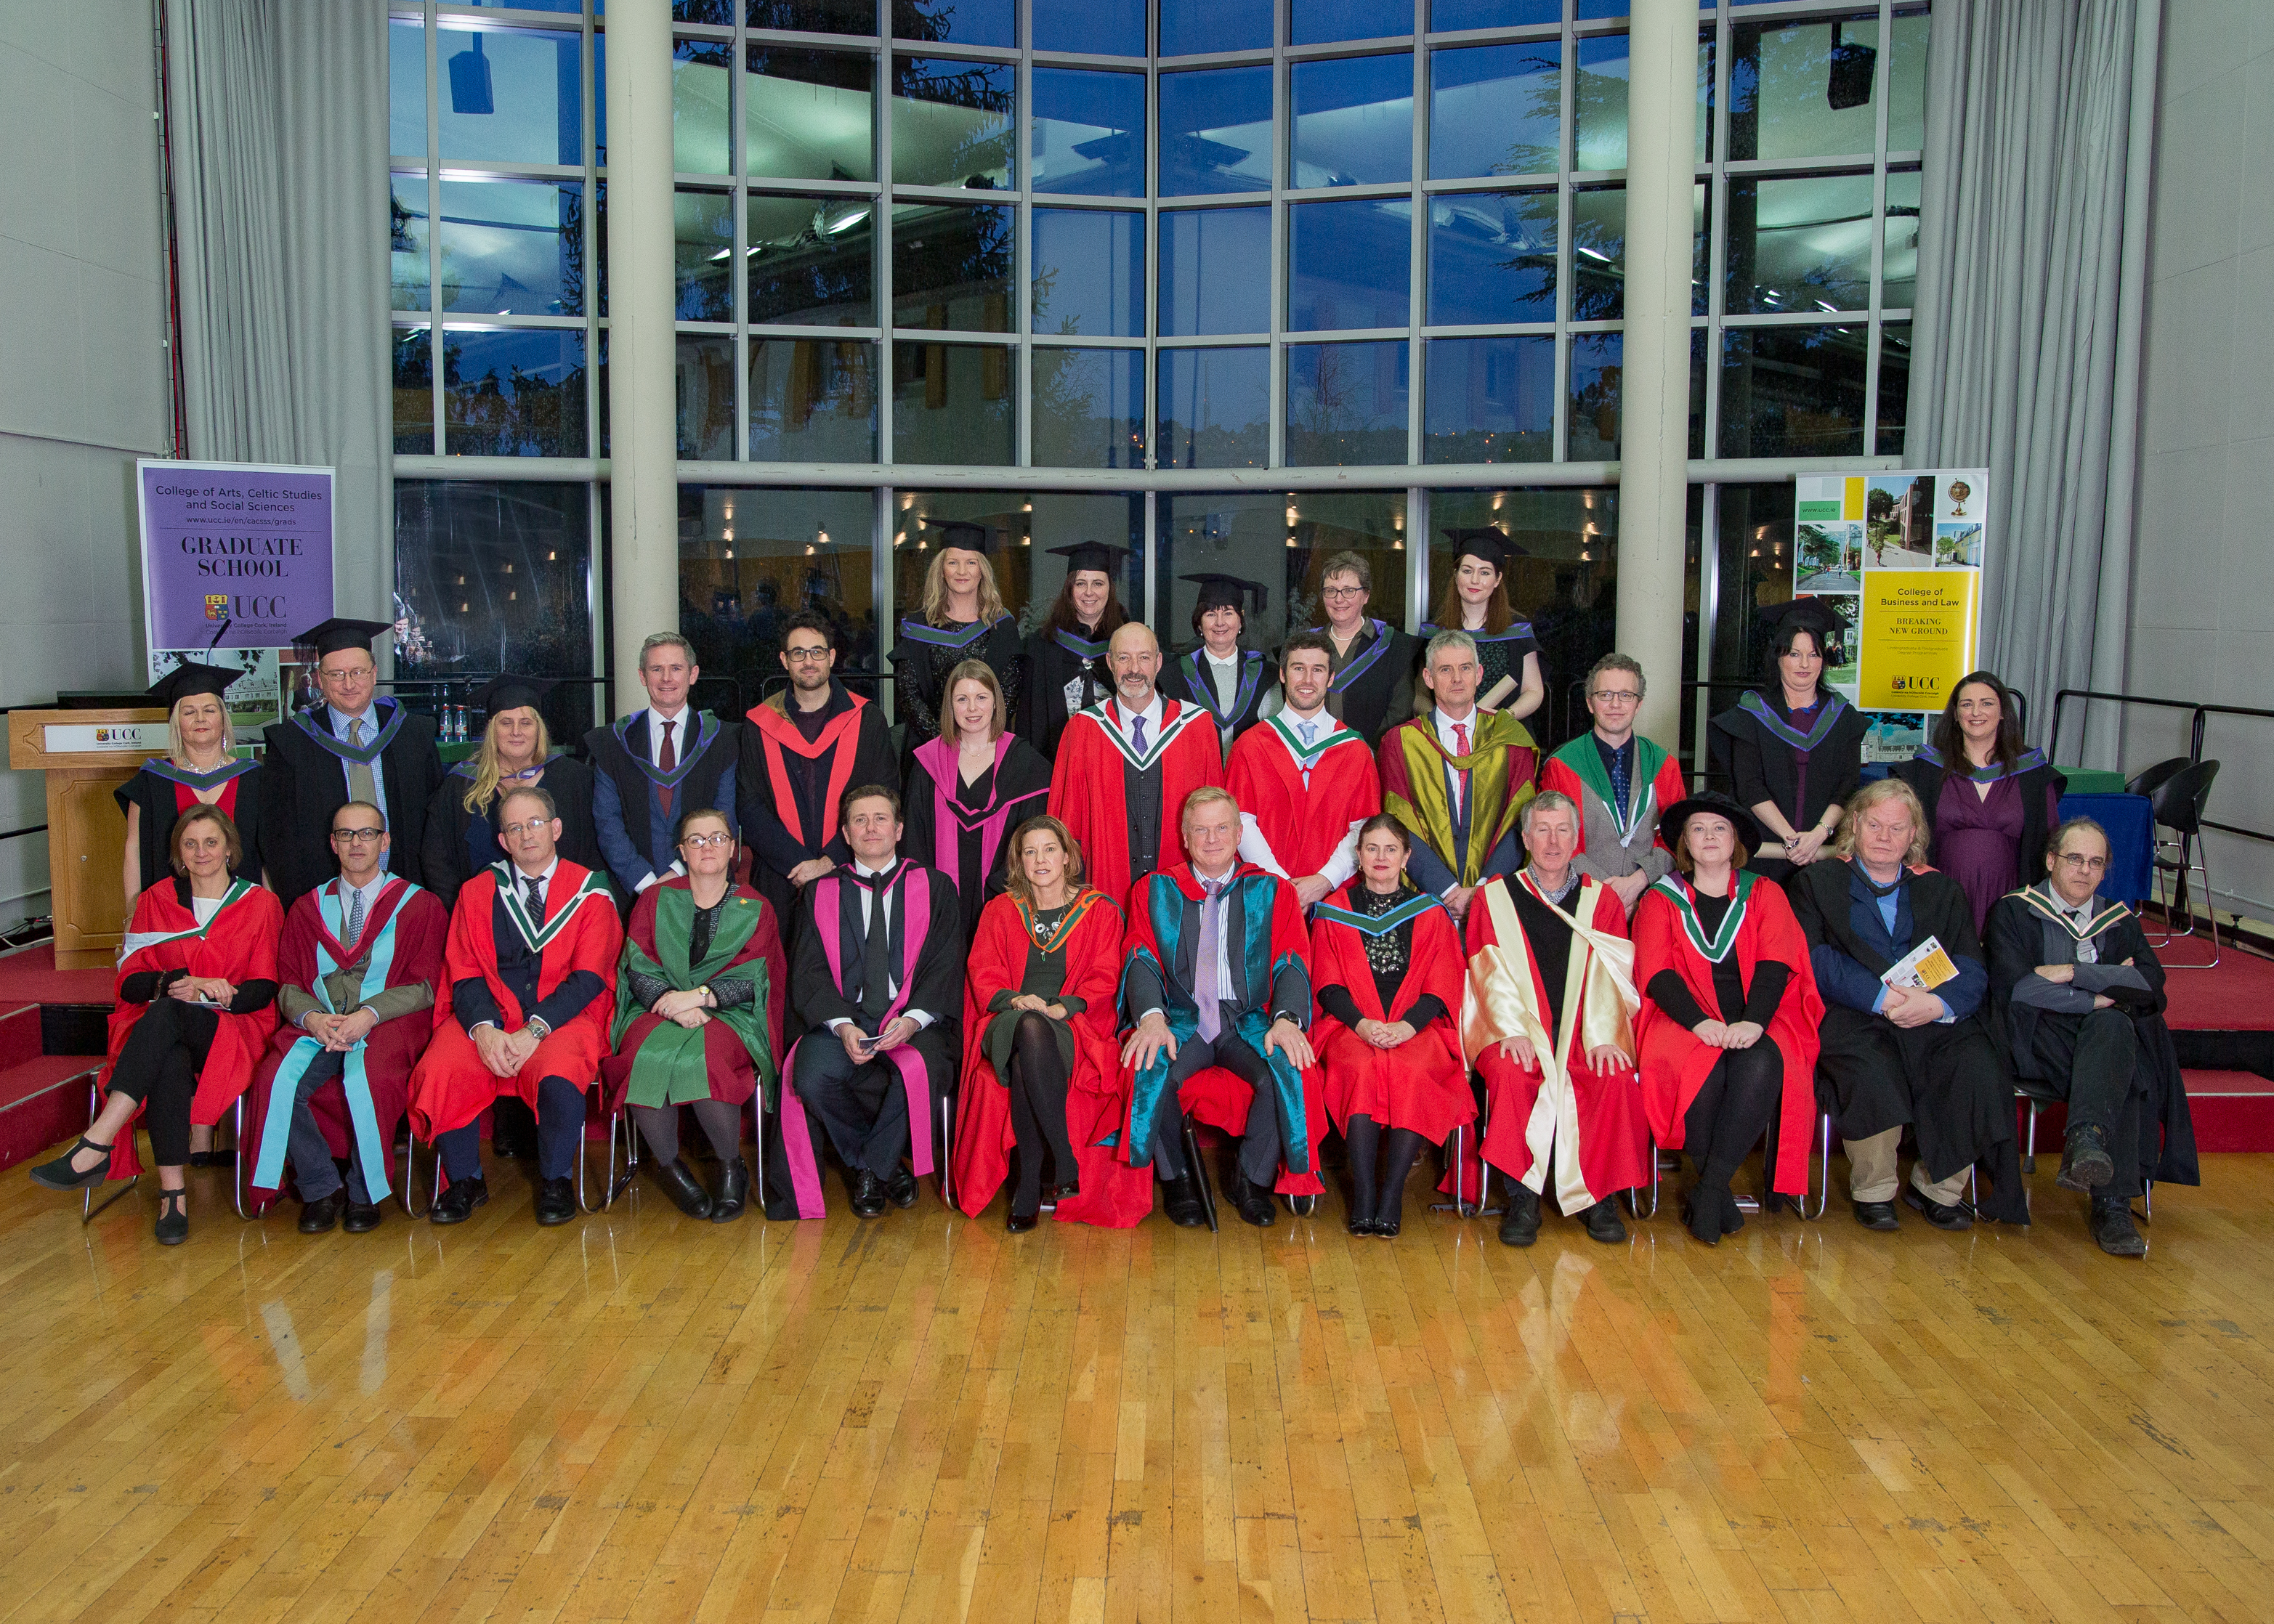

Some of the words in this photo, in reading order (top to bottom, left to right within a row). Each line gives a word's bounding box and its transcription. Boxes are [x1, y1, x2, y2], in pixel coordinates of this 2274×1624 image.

[155, 485, 200, 498] College
[203, 487, 215, 497] of
[218, 488, 244, 499] Arts,
[248, 489, 279, 499] Celtic
[282, 490, 322, 500] Studies
[186, 500, 207, 509] and
[211, 500, 244, 510] Social
[248, 502, 295, 511] Sciences
[186, 516, 296, 526] www.ucc.ie/en/cacsss/grads
[182, 536, 303, 556] GRADUATE
[198, 559, 289, 577] SCHOOL
[232, 596, 287, 619] UCC
[1909, 676, 1940, 690] UCC
[111, 728, 141, 740] UCC
